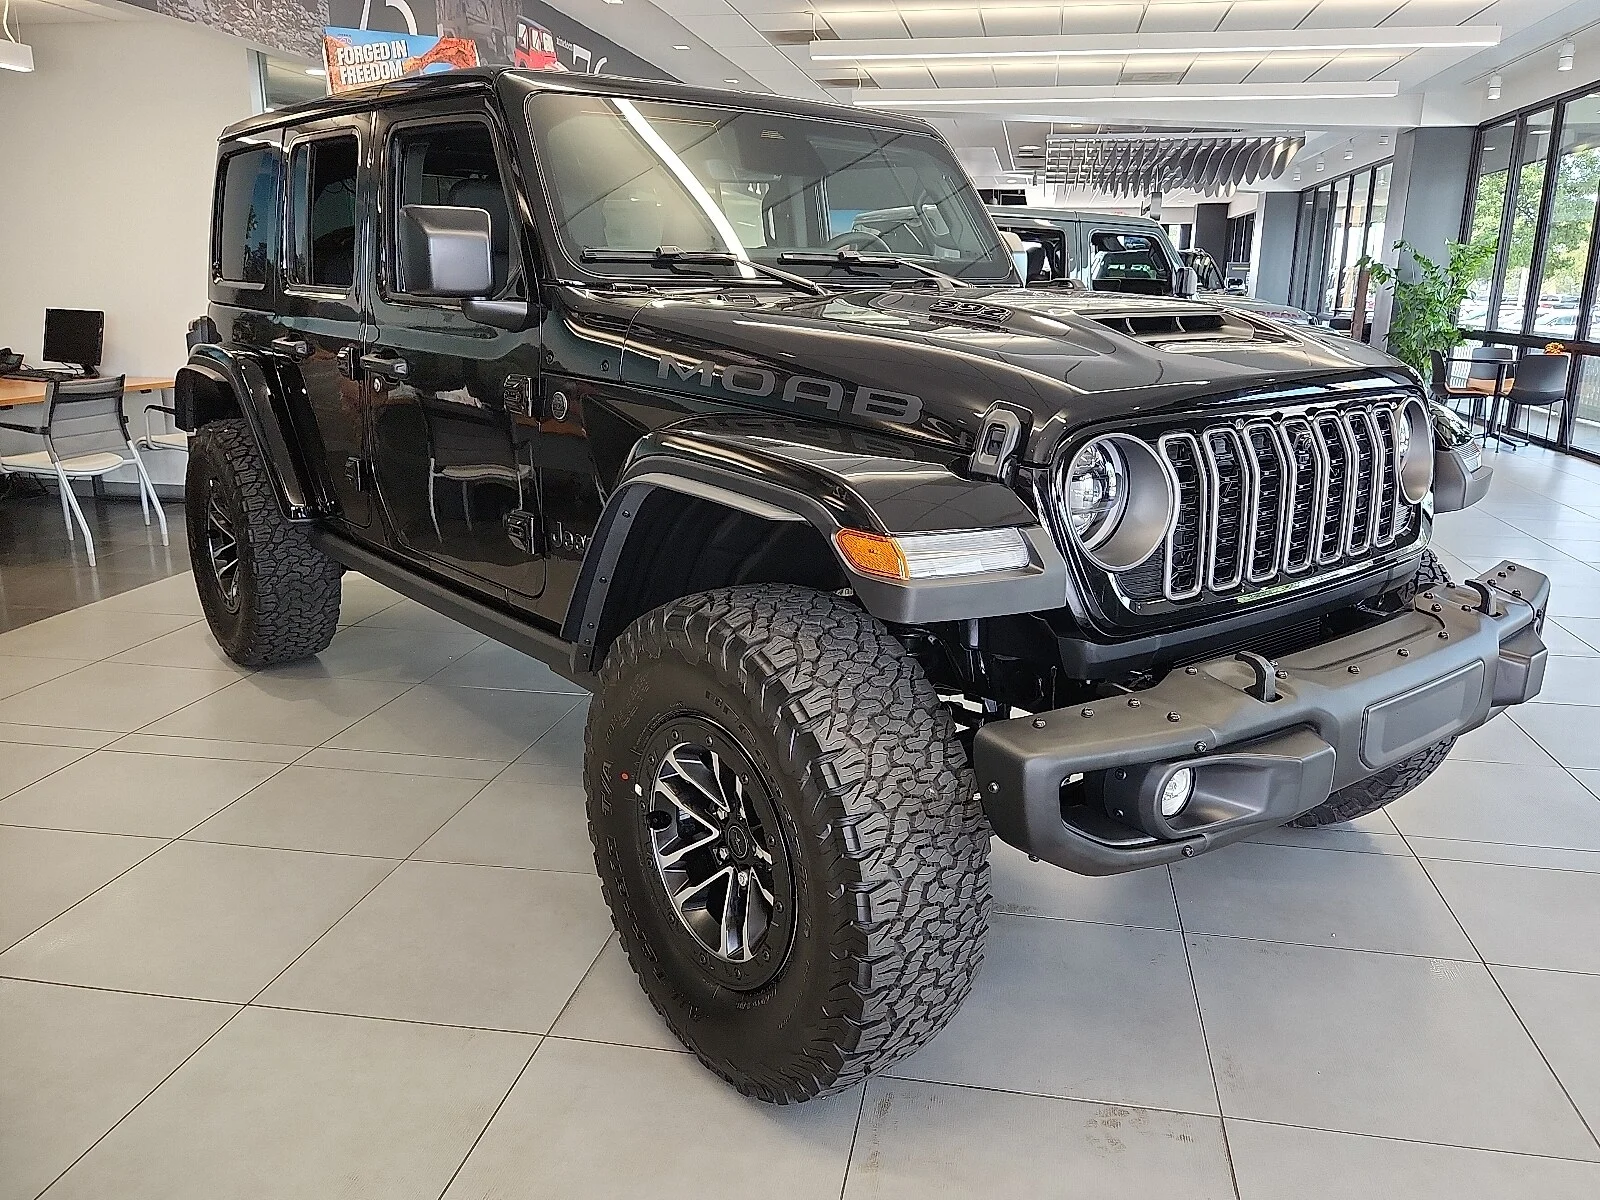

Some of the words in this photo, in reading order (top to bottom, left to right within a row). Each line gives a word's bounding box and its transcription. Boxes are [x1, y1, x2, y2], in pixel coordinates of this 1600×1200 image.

[337, 41, 391, 67] FORGED
[391, 40, 408, 59] IN
[340, 59, 404, 85] FREEDOM
[929, 299, 1012, 324] 392
[656, 354, 924, 425] MOAB
[551, 521, 591, 551] Jee
